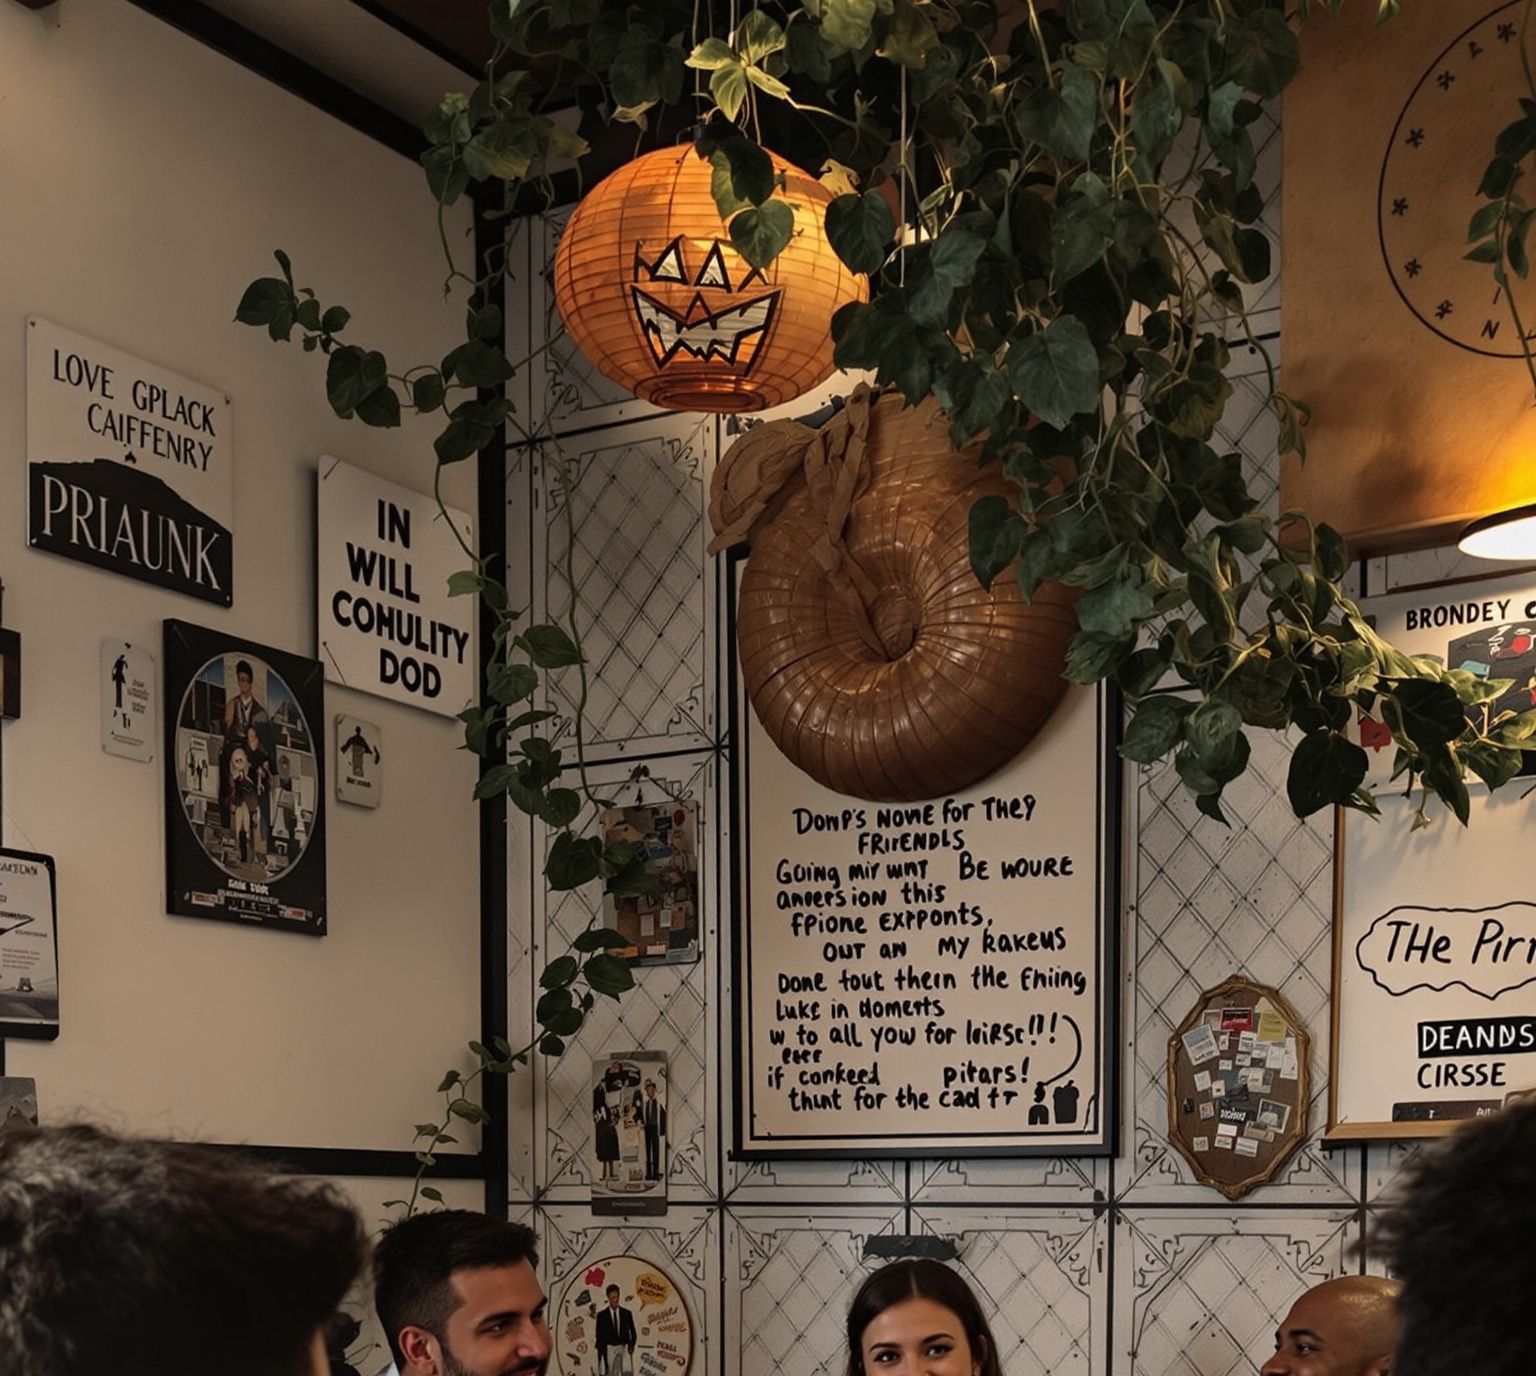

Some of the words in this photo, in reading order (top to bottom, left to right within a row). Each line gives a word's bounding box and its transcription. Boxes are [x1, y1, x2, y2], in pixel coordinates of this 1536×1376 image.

[53, 349, 115, 400] LOVE
[132, 379, 216, 438] GPLACK
[41, 473, 222, 591] PRIAUNK
[377, 498, 411, 550] IN
[345, 540, 421, 604] WILL
[1406, 598, 1512, 631] BRONDEY
[379, 647, 442, 699] DOD
[829, 1022, 863, 1048] all
[767, 1065, 785, 1091] if
[1417, 1062, 1507, 1089] CIRSSE
[894, 1083, 930, 1111] the
